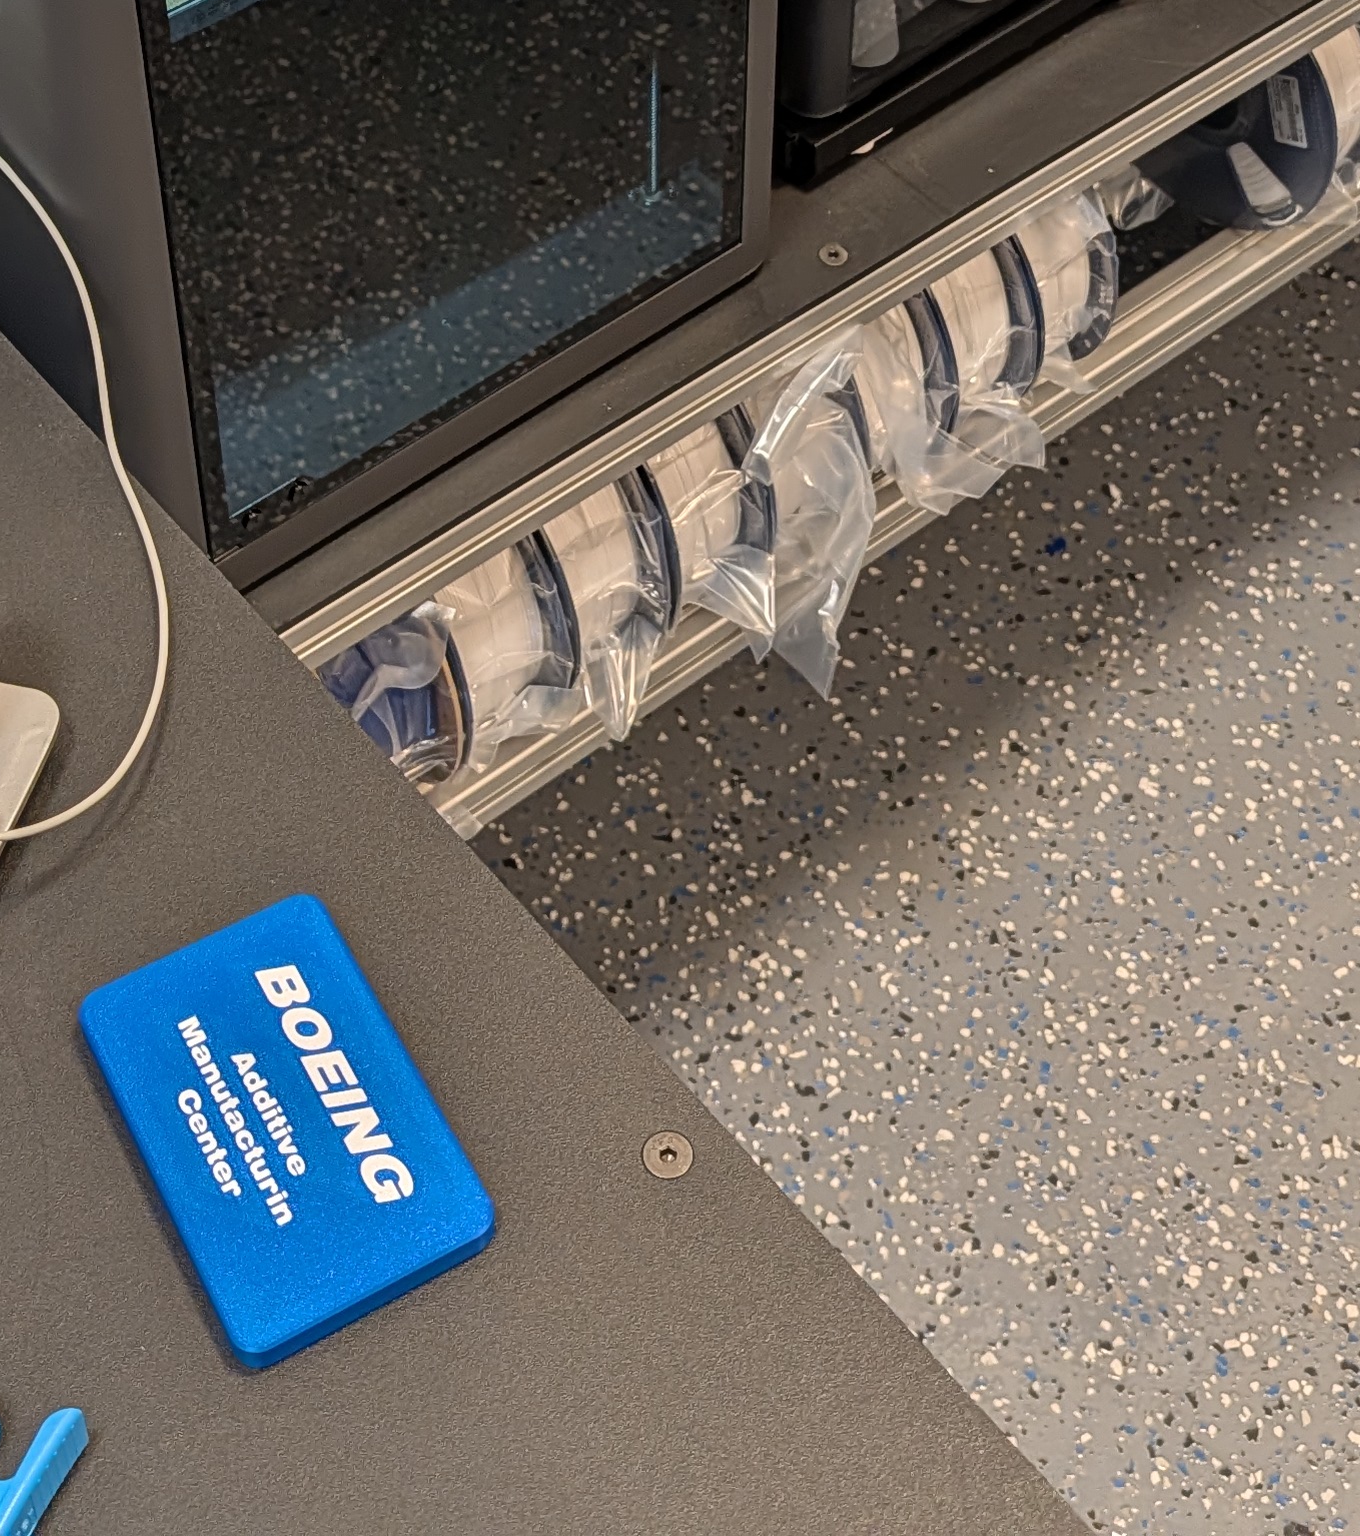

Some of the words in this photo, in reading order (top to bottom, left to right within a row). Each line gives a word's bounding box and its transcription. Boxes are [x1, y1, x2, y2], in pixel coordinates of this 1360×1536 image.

[178, 1089, 242, 1197] Center
[230, 1052, 306, 1176] Additive
[255, 965, 414, 1204] BOEING
